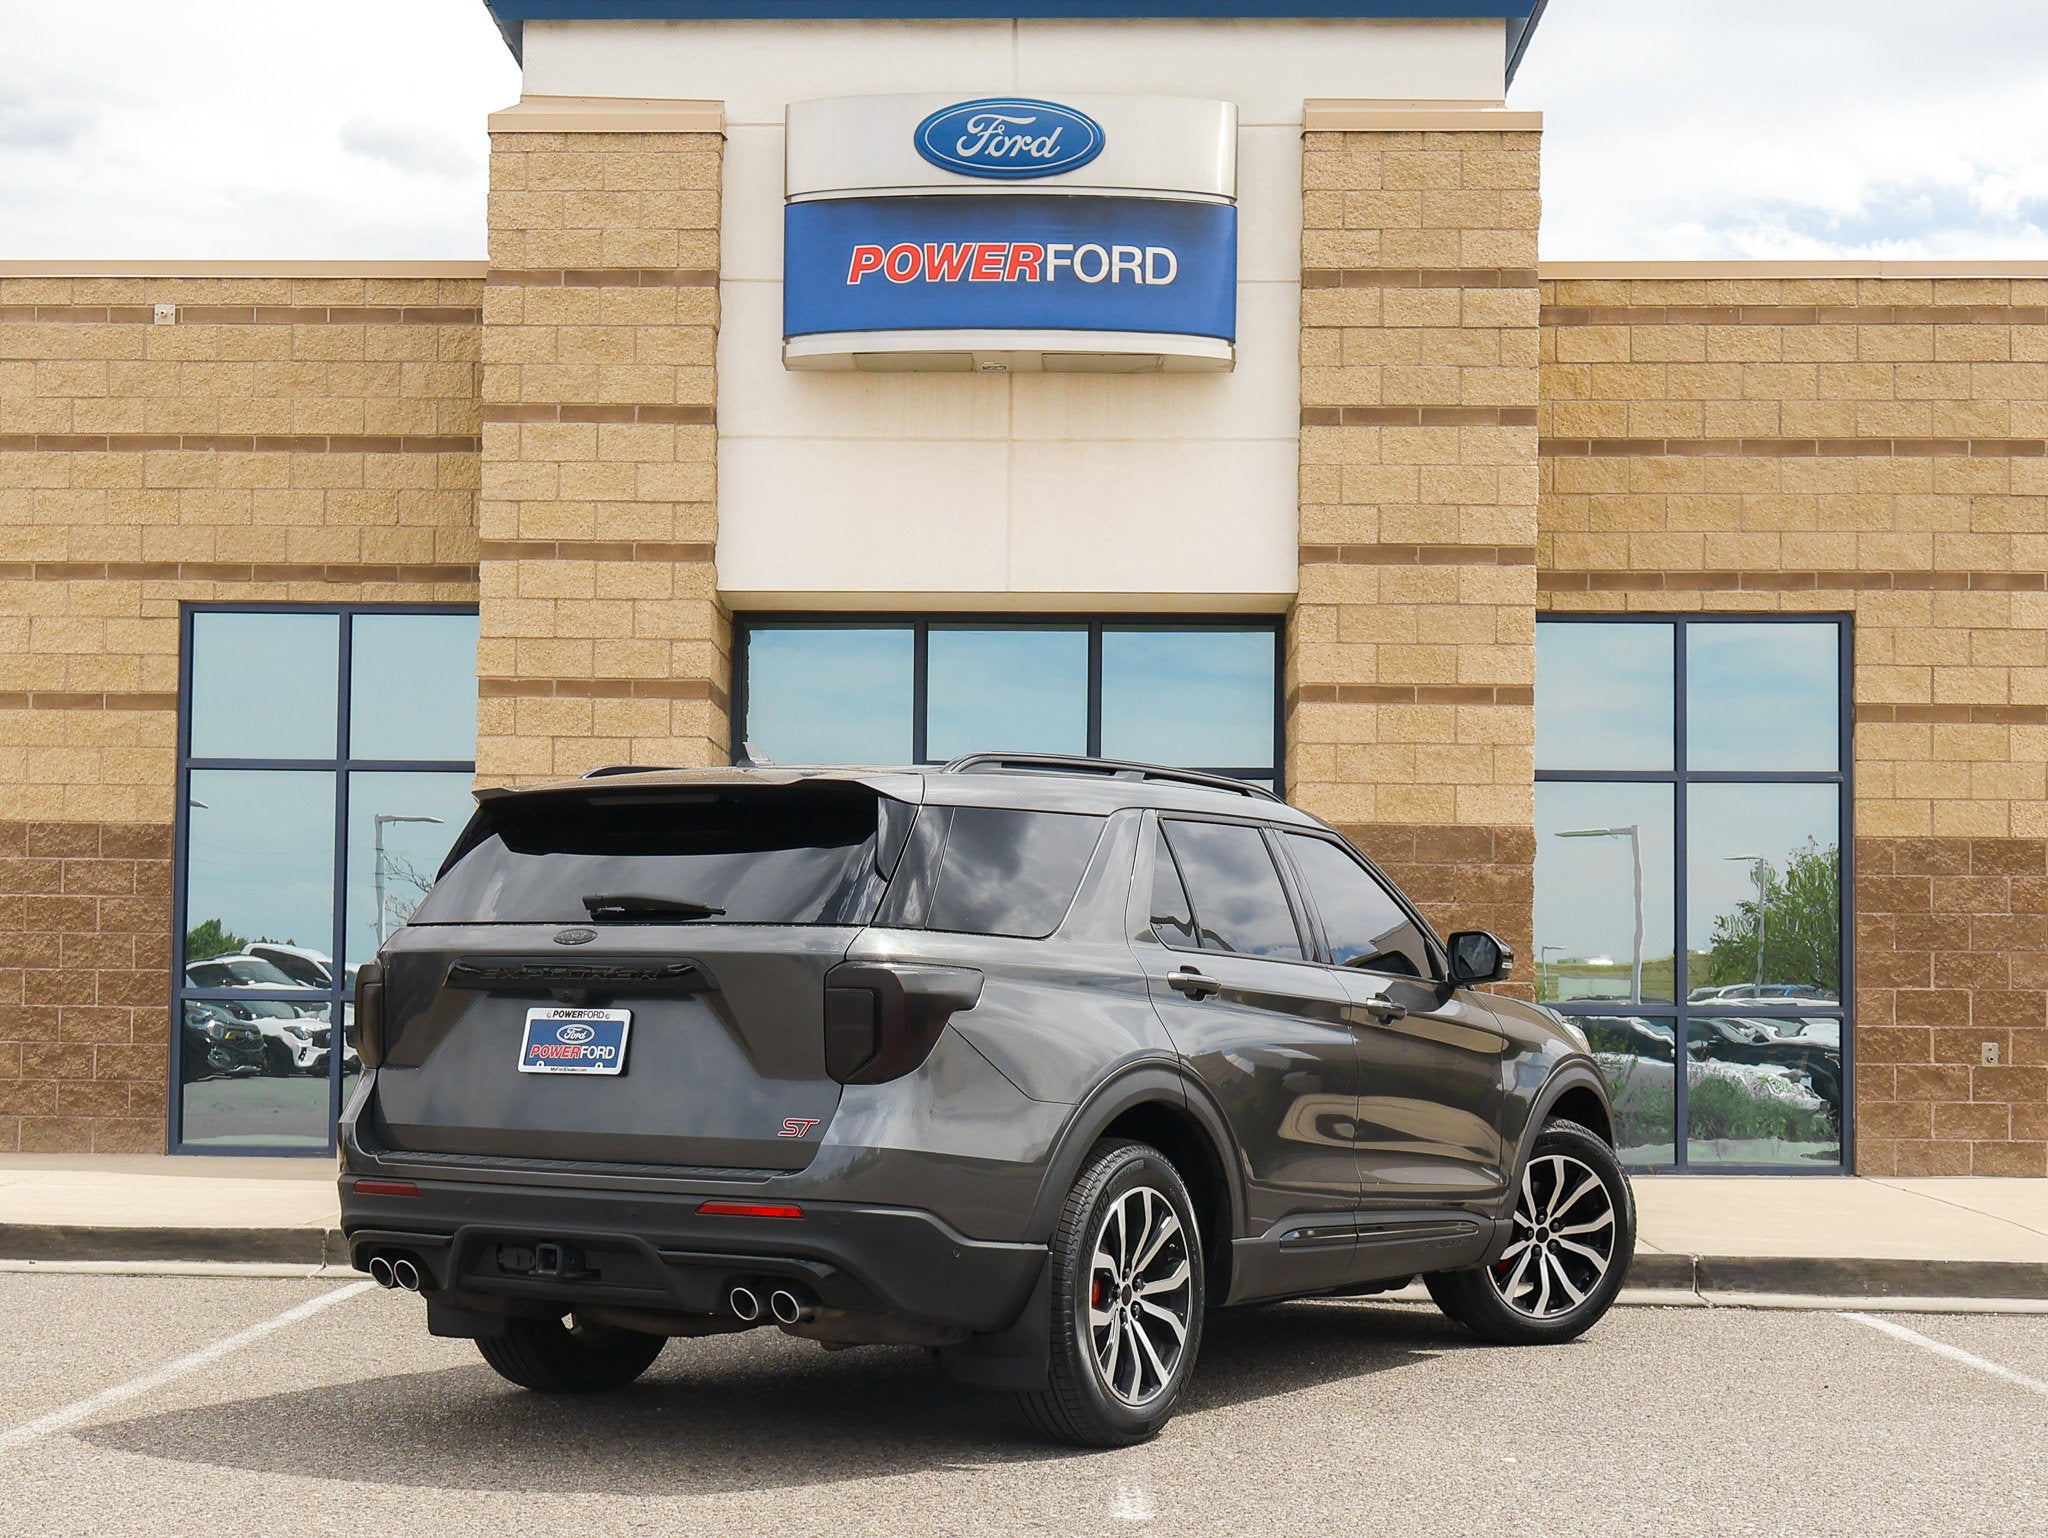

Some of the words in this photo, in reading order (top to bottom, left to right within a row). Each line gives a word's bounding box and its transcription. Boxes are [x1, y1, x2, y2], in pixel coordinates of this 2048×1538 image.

[956, 113, 1062, 158] Ford
[563, 1027, 587, 1040] Ford
[778, 1118, 820, 1137] ST
